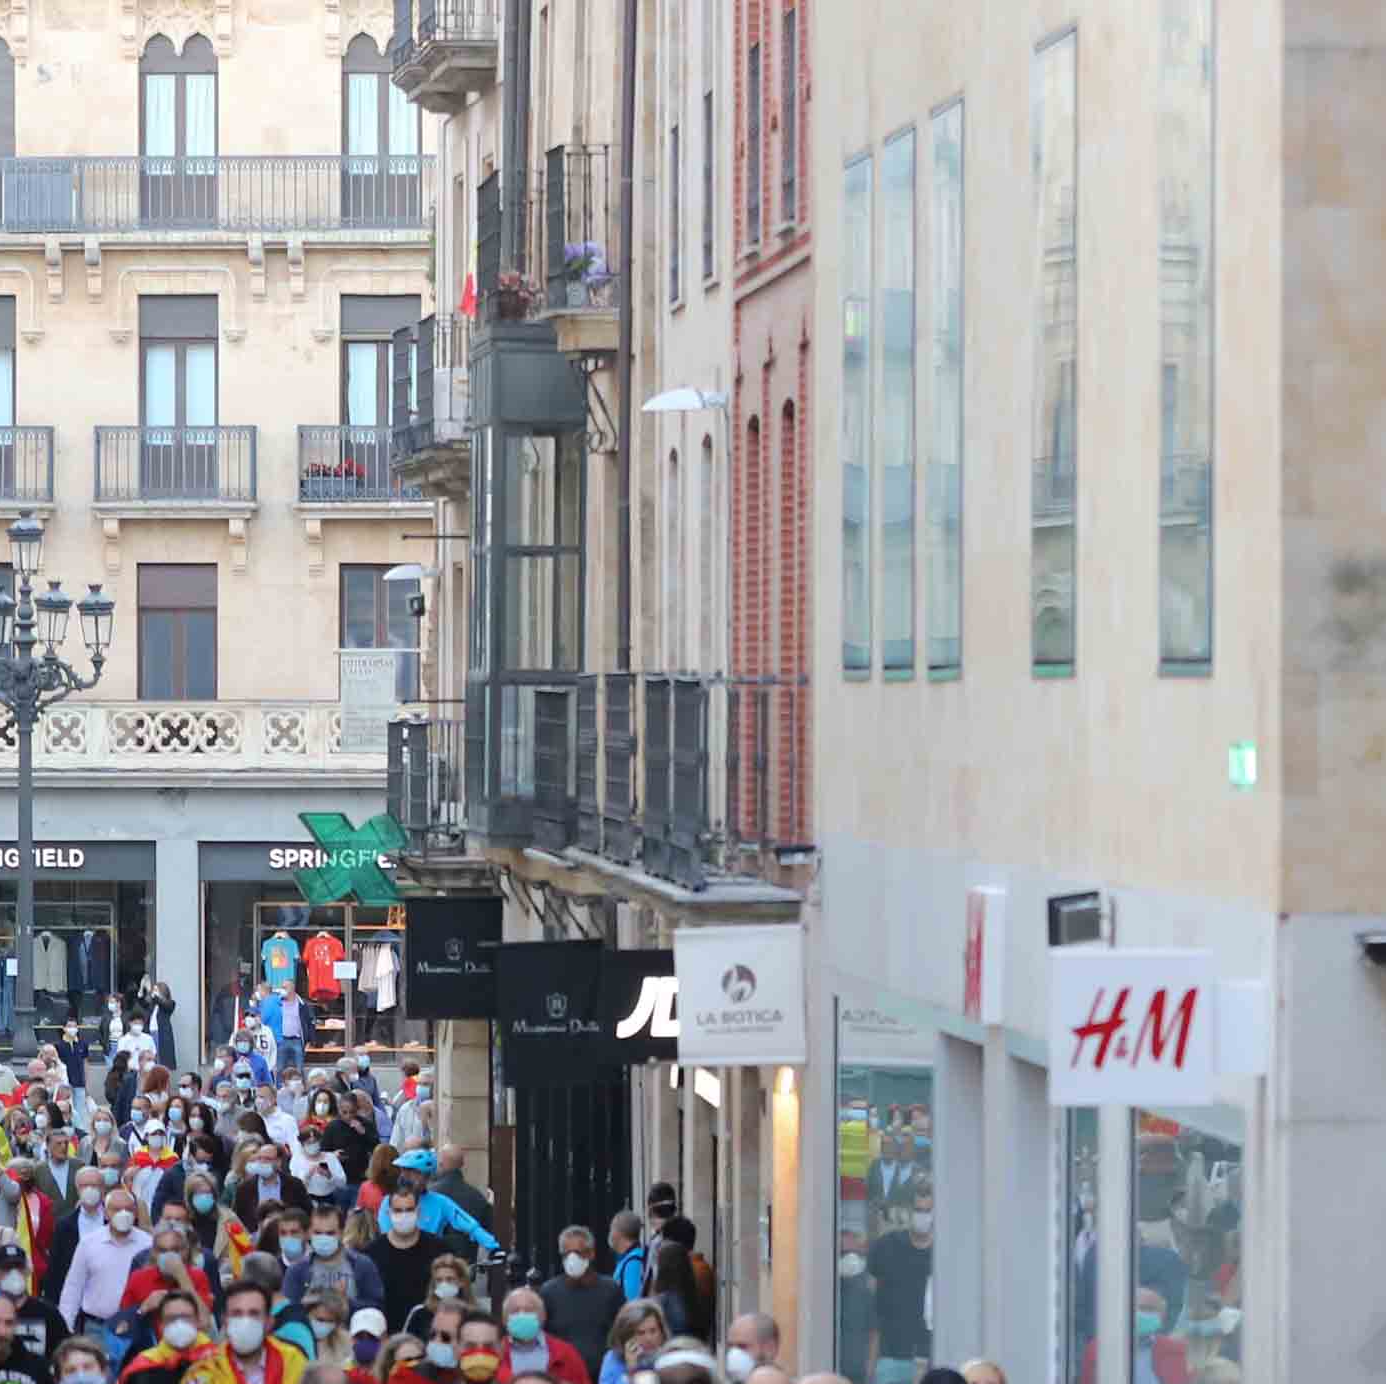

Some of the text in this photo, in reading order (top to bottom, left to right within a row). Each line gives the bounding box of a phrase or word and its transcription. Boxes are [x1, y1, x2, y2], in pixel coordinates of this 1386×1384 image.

[696, 1009, 784, 1026] LA BOTICA
[1071, 986, 1198, 1070] H&M
